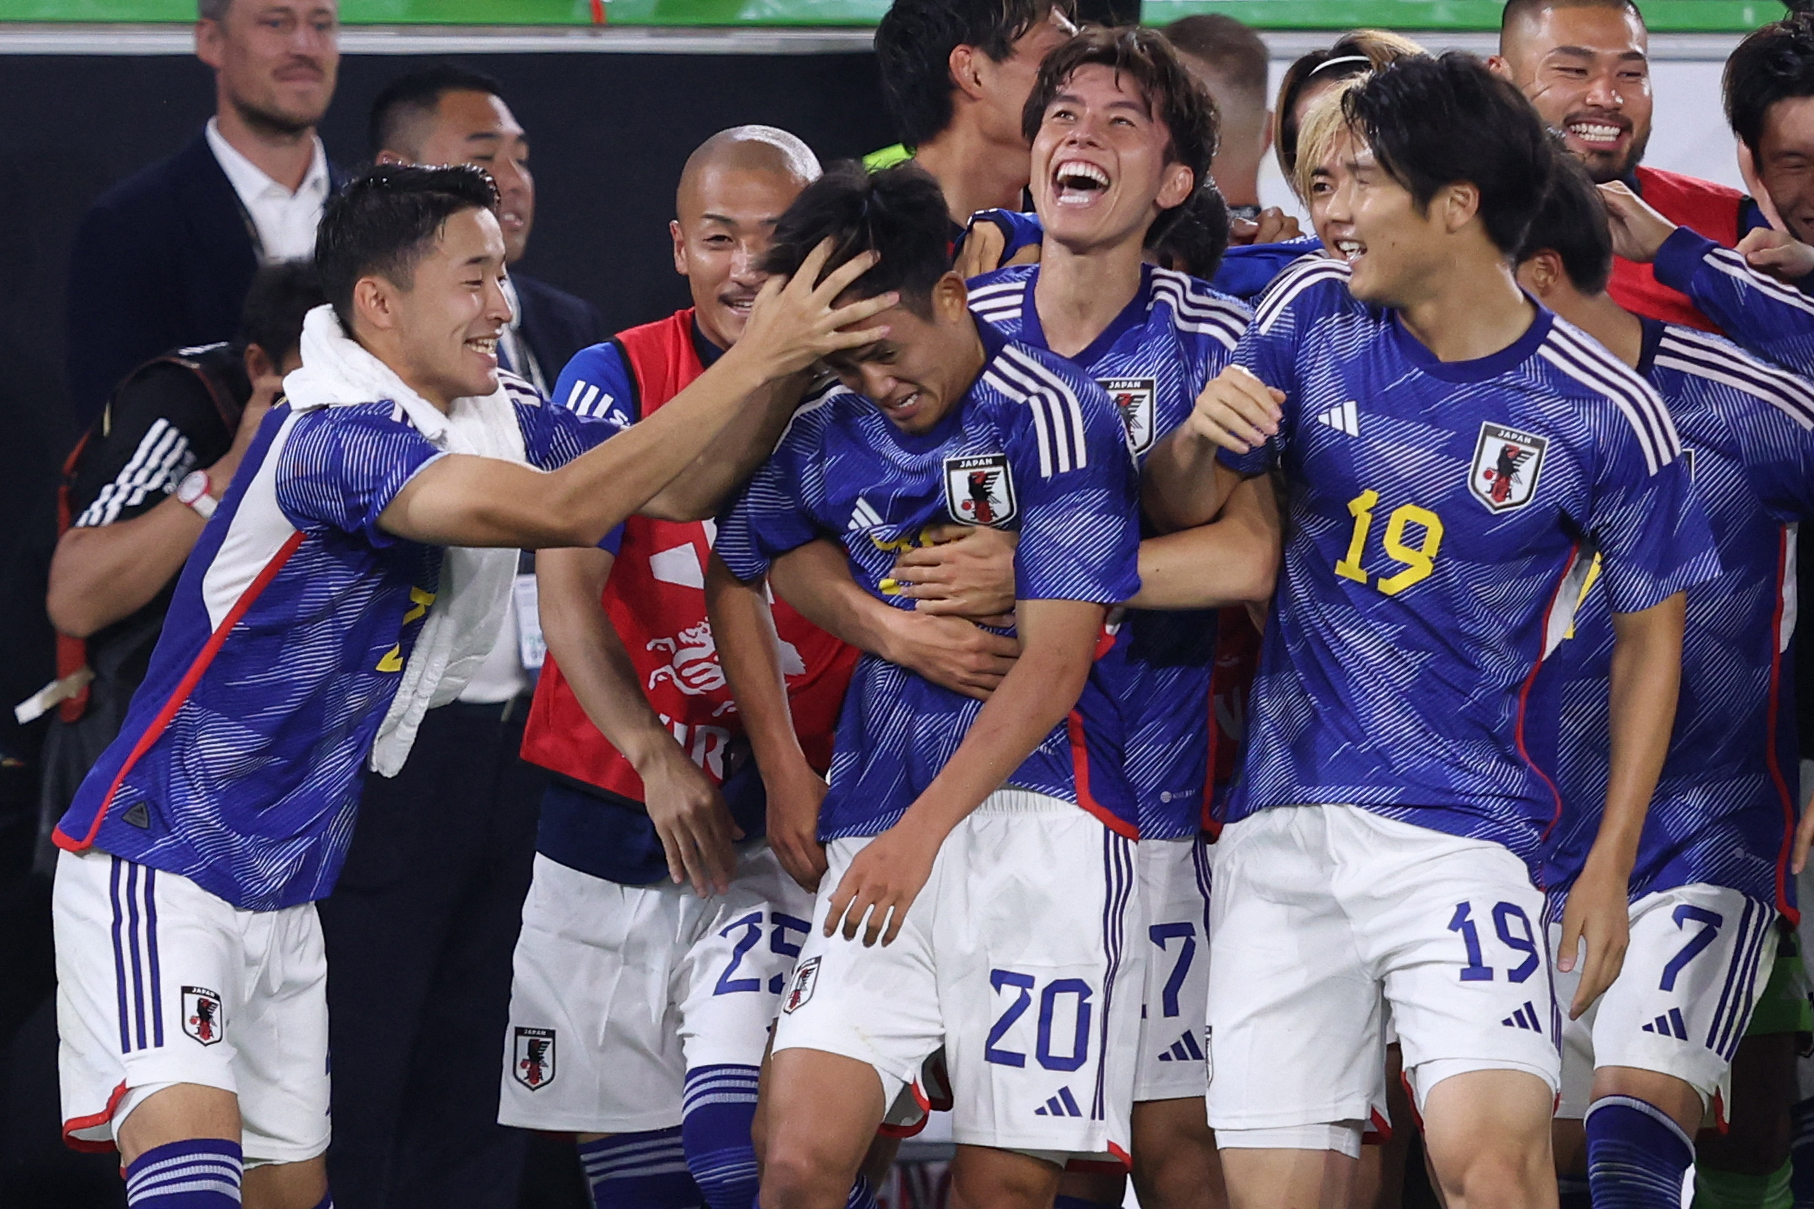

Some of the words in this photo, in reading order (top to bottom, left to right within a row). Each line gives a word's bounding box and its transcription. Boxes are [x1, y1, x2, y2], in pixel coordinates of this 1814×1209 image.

[1108, 381, 1141, 389] JAPAN
[960, 458, 993, 468] JAPAN
[1497, 429, 1532, 444] JAPAN
[1334, 488, 1445, 596] 19
[1447, 901, 1540, 983] 19
[1658, 904, 1723, 993] 7
[984, 968, 1093, 1072] 20
